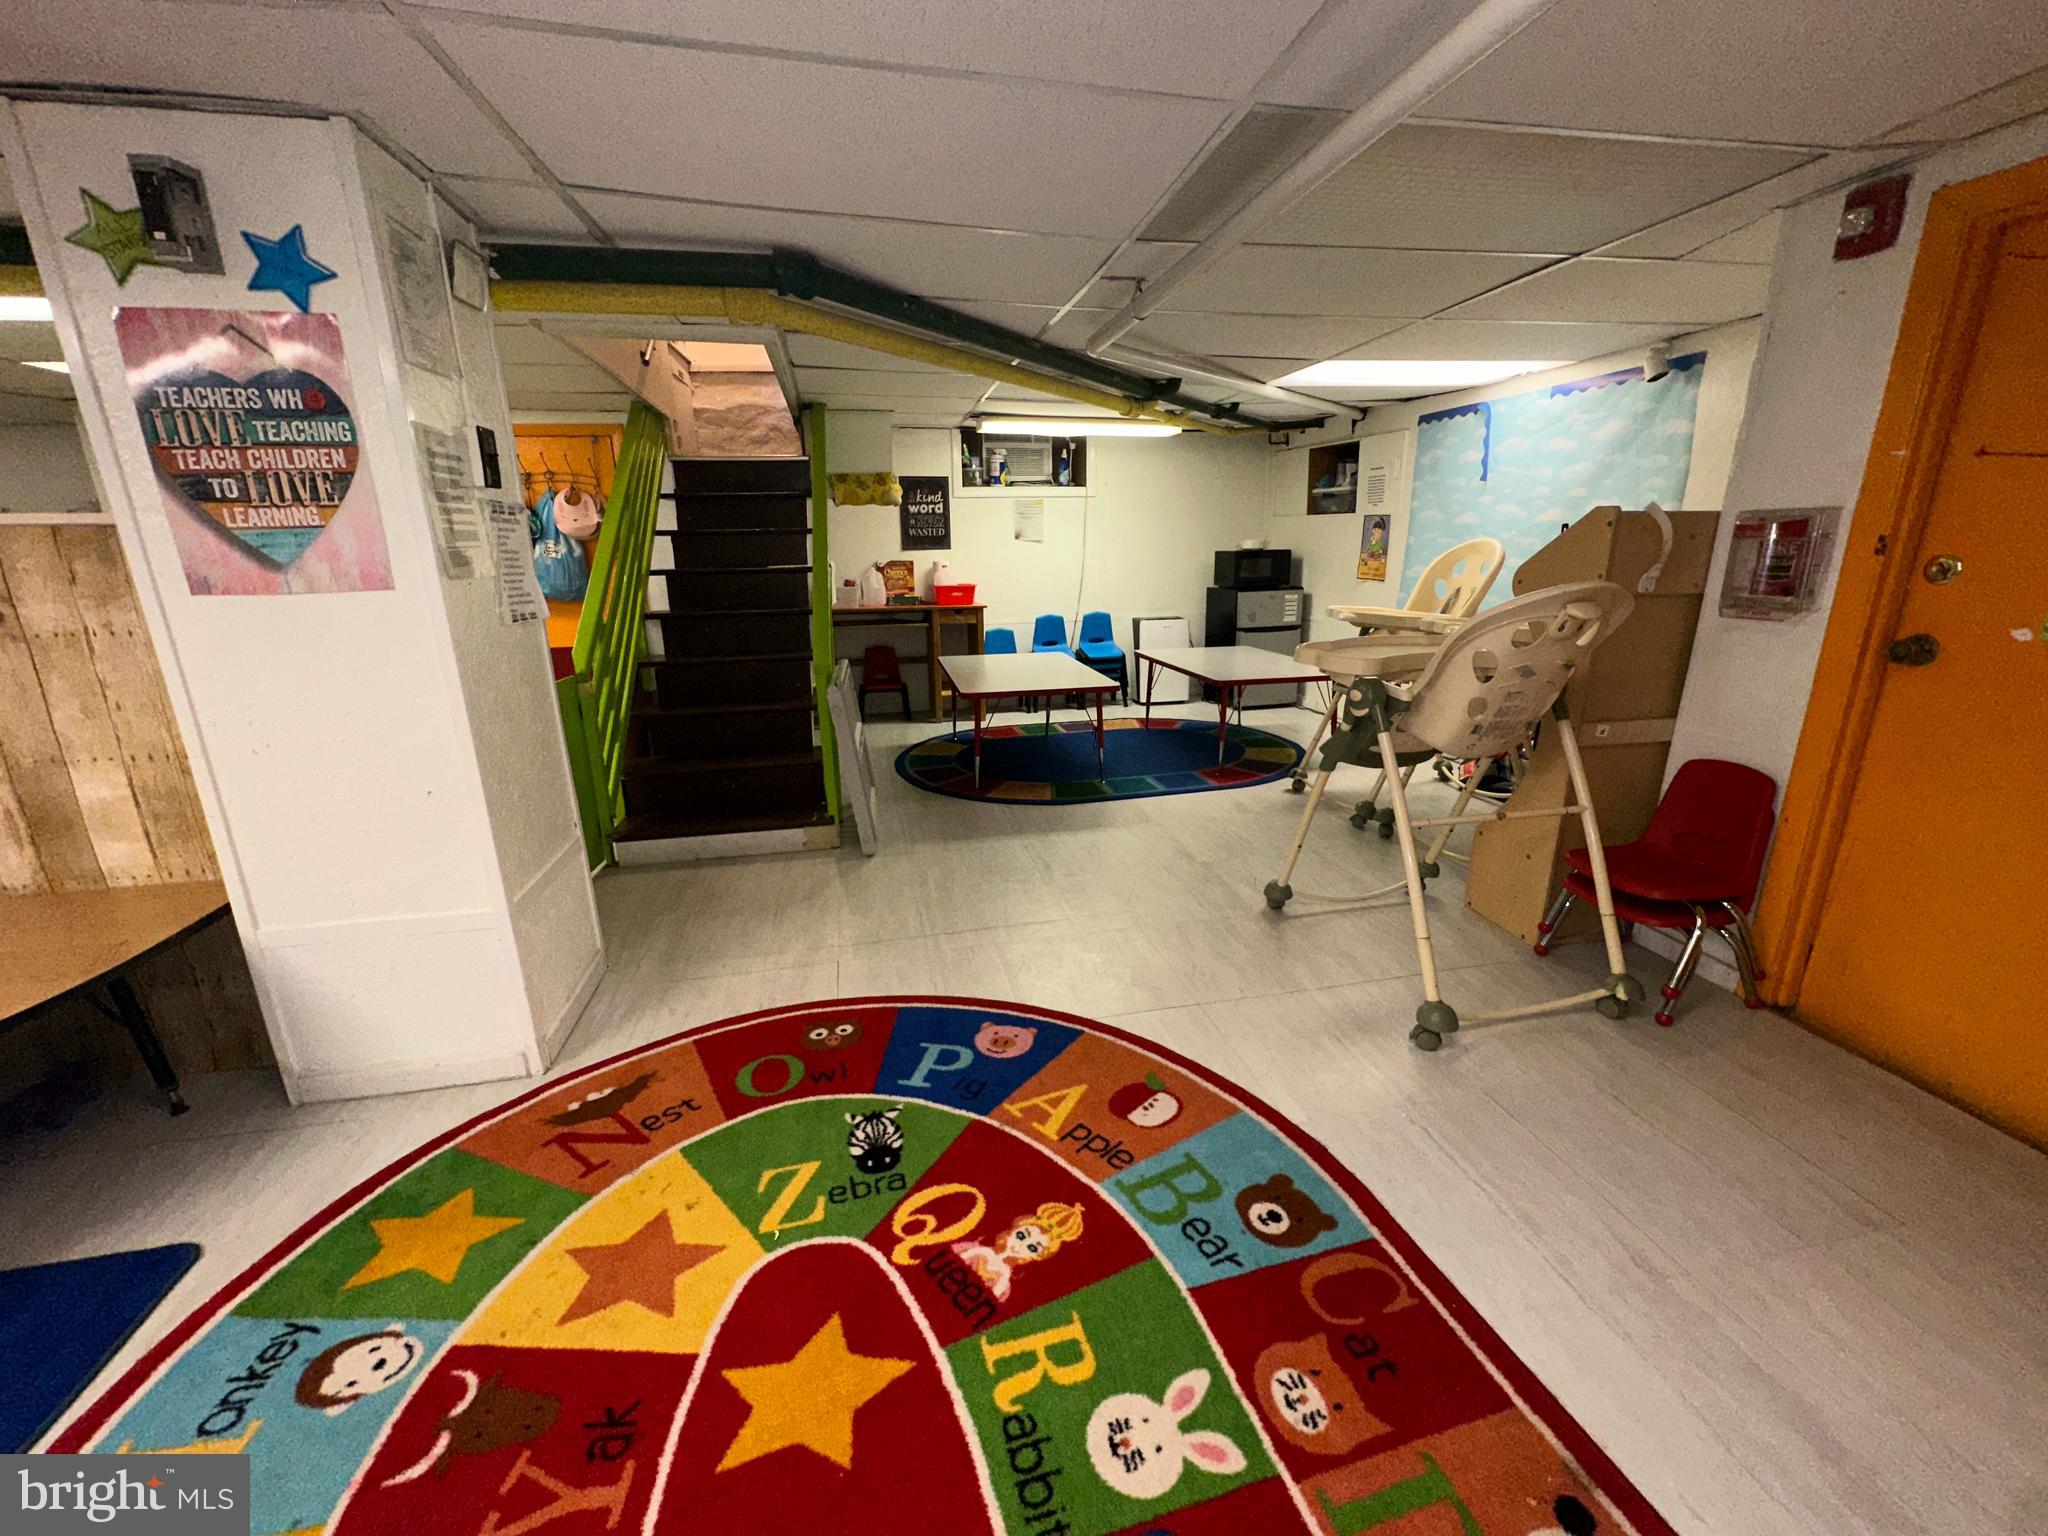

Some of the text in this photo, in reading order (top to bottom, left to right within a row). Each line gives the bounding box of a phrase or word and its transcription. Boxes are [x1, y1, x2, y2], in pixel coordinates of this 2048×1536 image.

[155, 386, 263, 409] TEACHERS
[150, 408, 352, 447] LOVE TEACHING
[172, 449, 347, 469] TEACH CHILDREN
[208, 470, 340, 506] TO LOVE
[222, 506, 325, 528] LEARNING.
[908, 502, 943, 514] word
[916, 489, 944, 503] kind
[908, 528, 945, 537] WASTED
[735, 1054, 849, 1098] Owl
[897, 1042, 988, 1100] Pig
[540, 1096, 702, 1179] Nest
[1003, 1083, 1136, 1171] Apple
[758, 1160, 908, 1234] Zebra
[1115, 1152, 1244, 1271] Bear
[891, 1183, 999, 1330] Queen
[1300, 1253, 1420, 1382] Cat
[115, 1322, 321, 1454] onkey
[980, 1311, 1096, 1536] Rabbit
[479, 1400, 642, 1536] Yak
